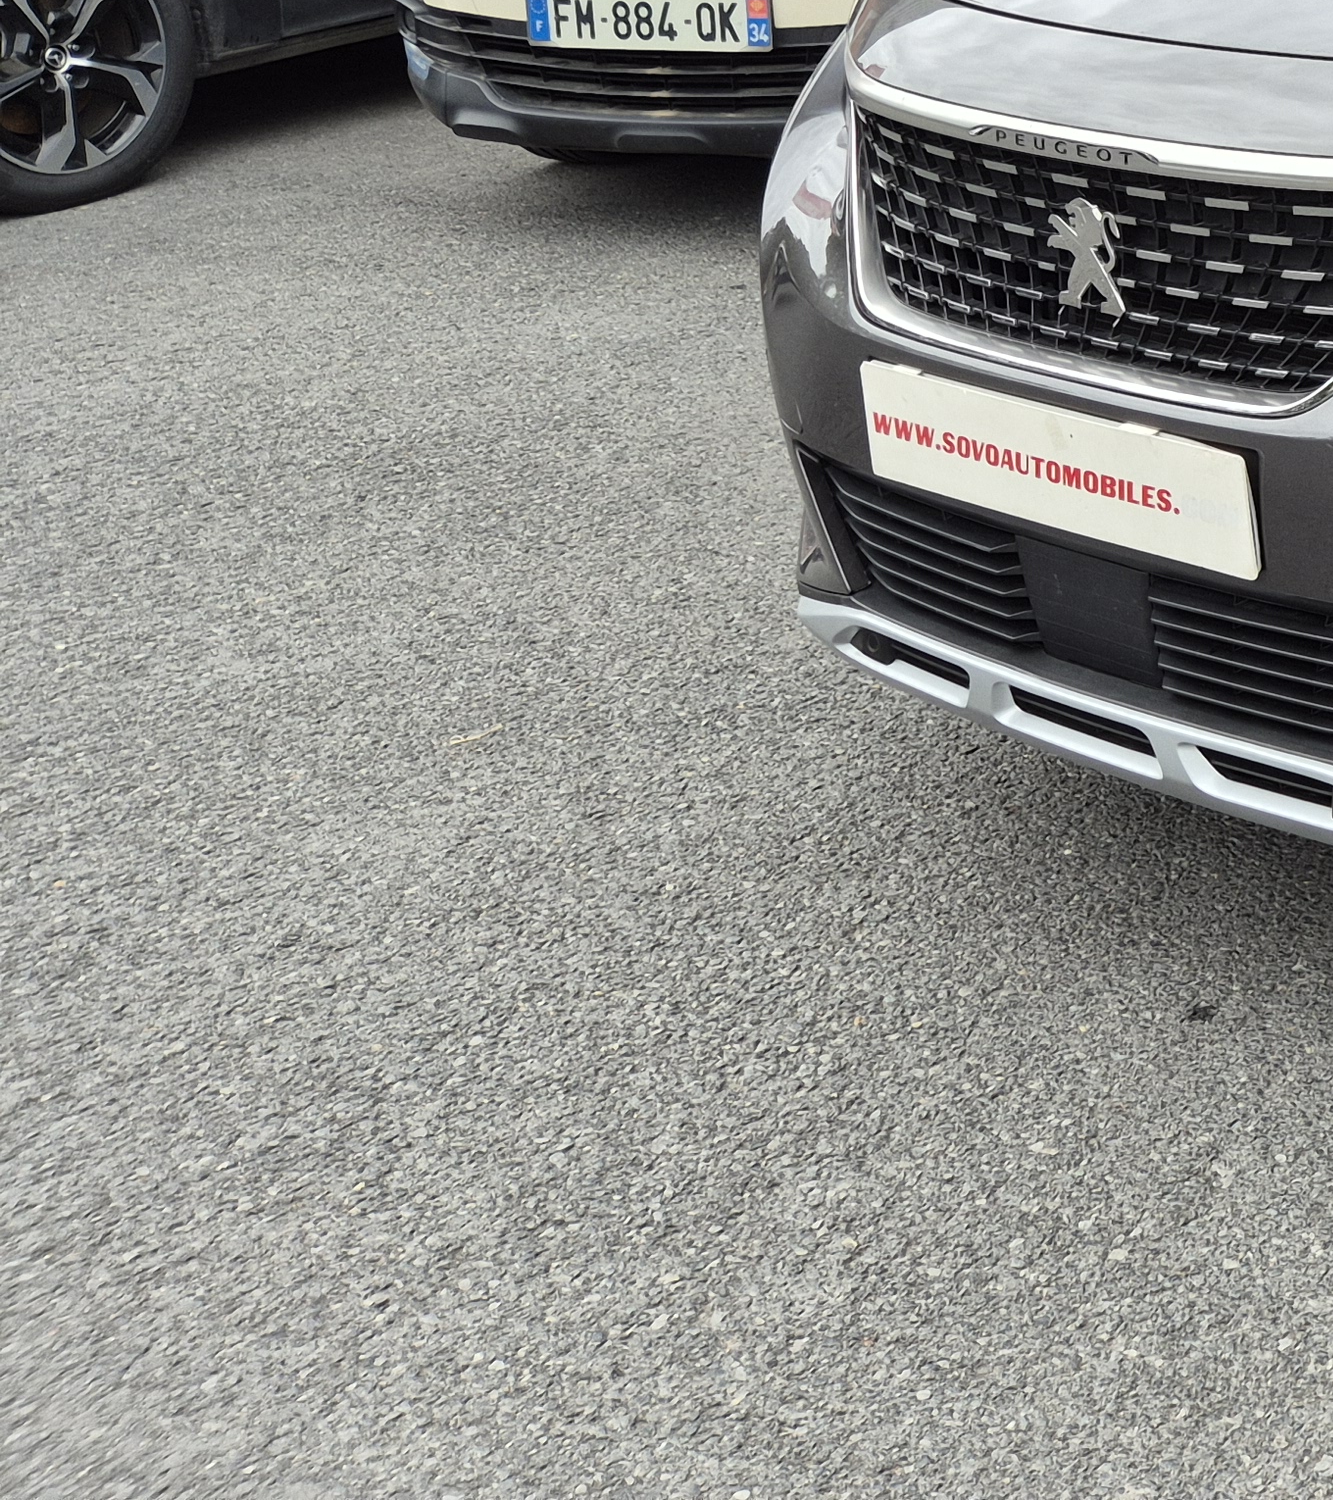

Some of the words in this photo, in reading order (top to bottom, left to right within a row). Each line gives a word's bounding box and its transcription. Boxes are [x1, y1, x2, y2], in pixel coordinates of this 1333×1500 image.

[535, 20, 544, 32] F
[749, 24, 769, 43] 34
[995, 129, 1133, 165] PEUGEOT
